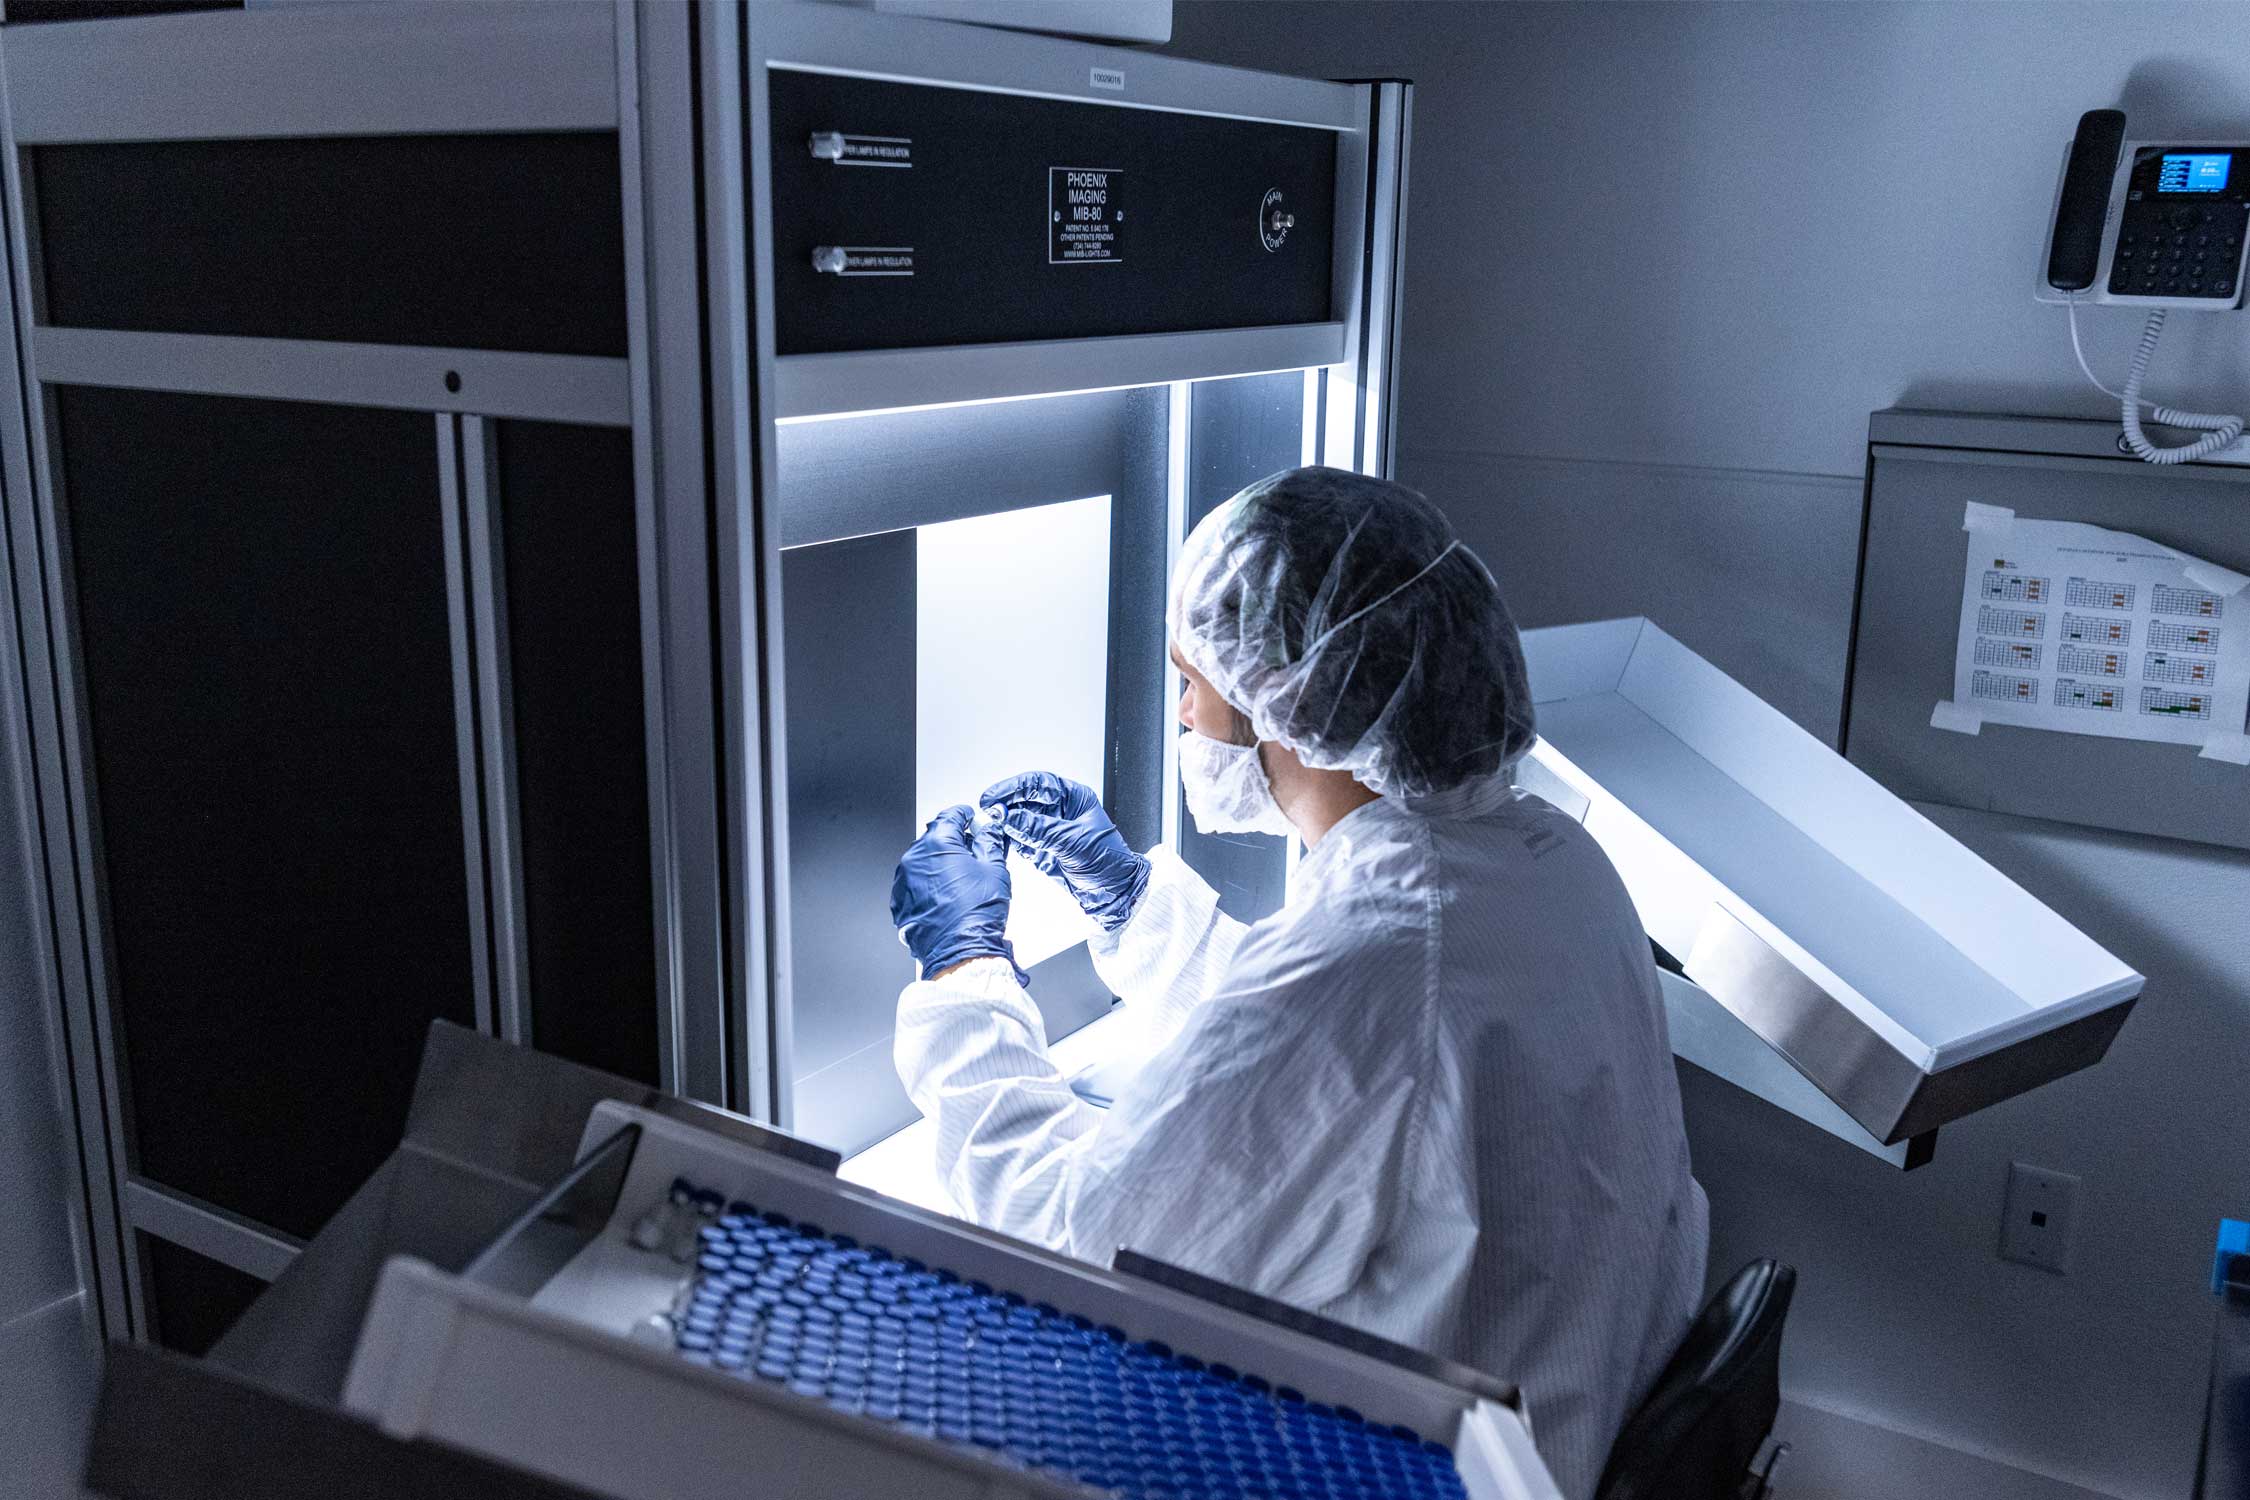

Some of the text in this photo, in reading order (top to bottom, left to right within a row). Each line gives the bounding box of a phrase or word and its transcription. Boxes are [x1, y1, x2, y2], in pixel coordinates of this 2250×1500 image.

[1068, 172, 1107, 187] PHOENIX
[1069, 189, 1106, 204] IMAGING
[1267, 191, 1282, 206] MAIN
[1073, 206, 1102, 221] MIB-80
[1266, 227, 1287, 248] POWER
